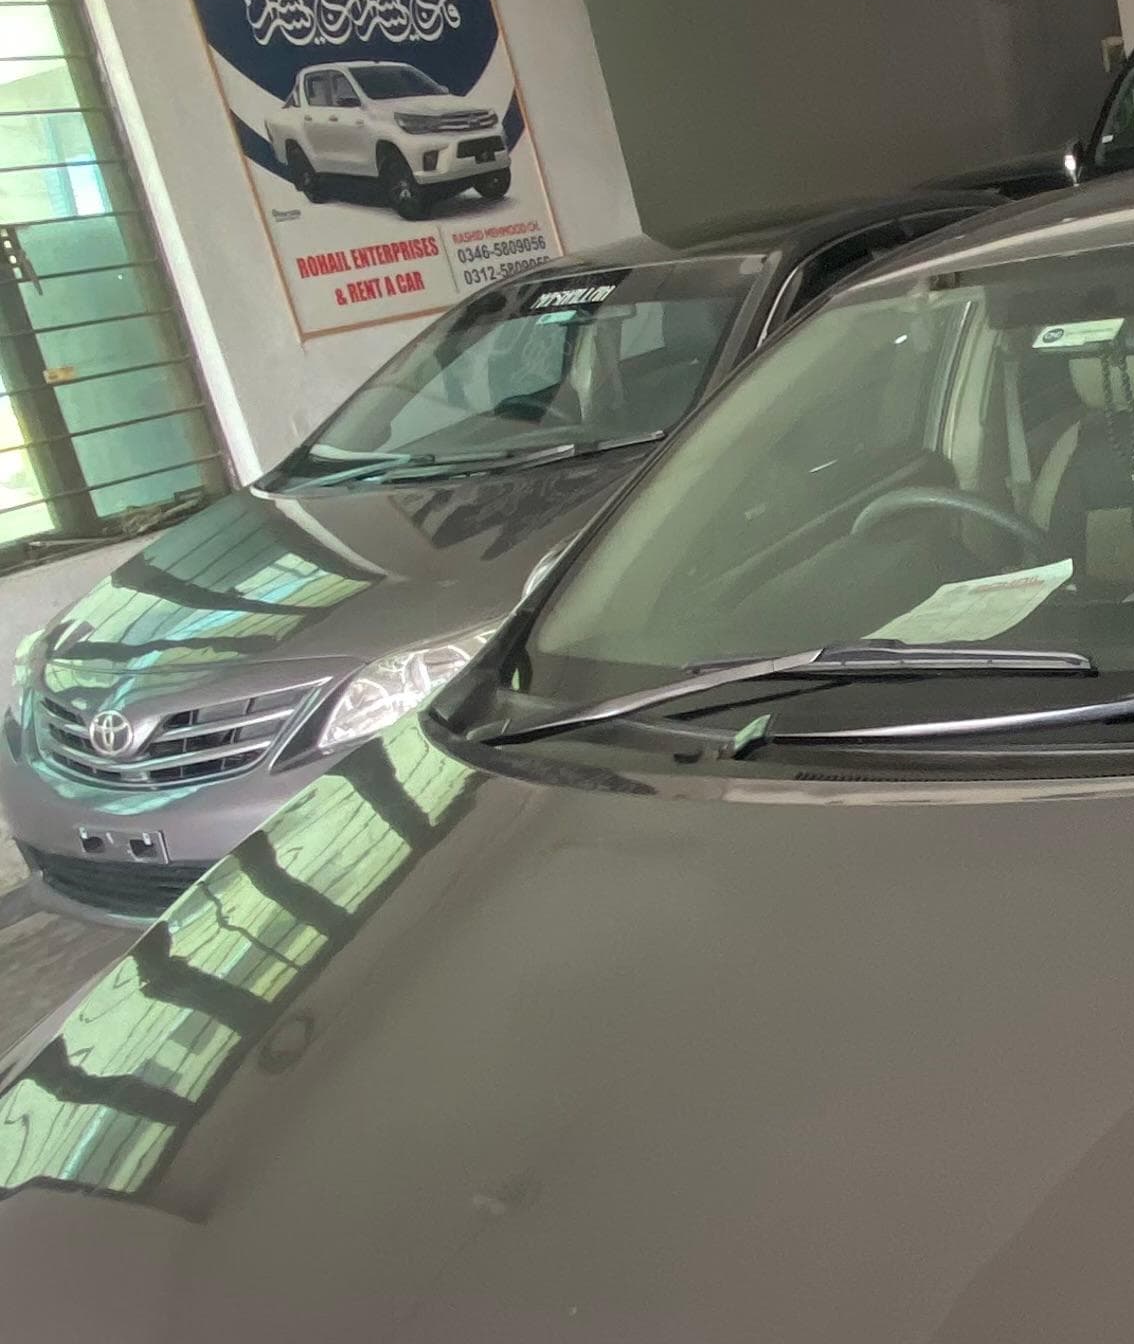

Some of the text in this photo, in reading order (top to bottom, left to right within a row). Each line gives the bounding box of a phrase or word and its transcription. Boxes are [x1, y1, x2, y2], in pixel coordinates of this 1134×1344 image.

[296, 236, 439, 279] ROHAIL ENTERPRISES
[457, 235, 547, 264] 0346-5809056
[335, 271, 425, 305] & RENT A CAR
